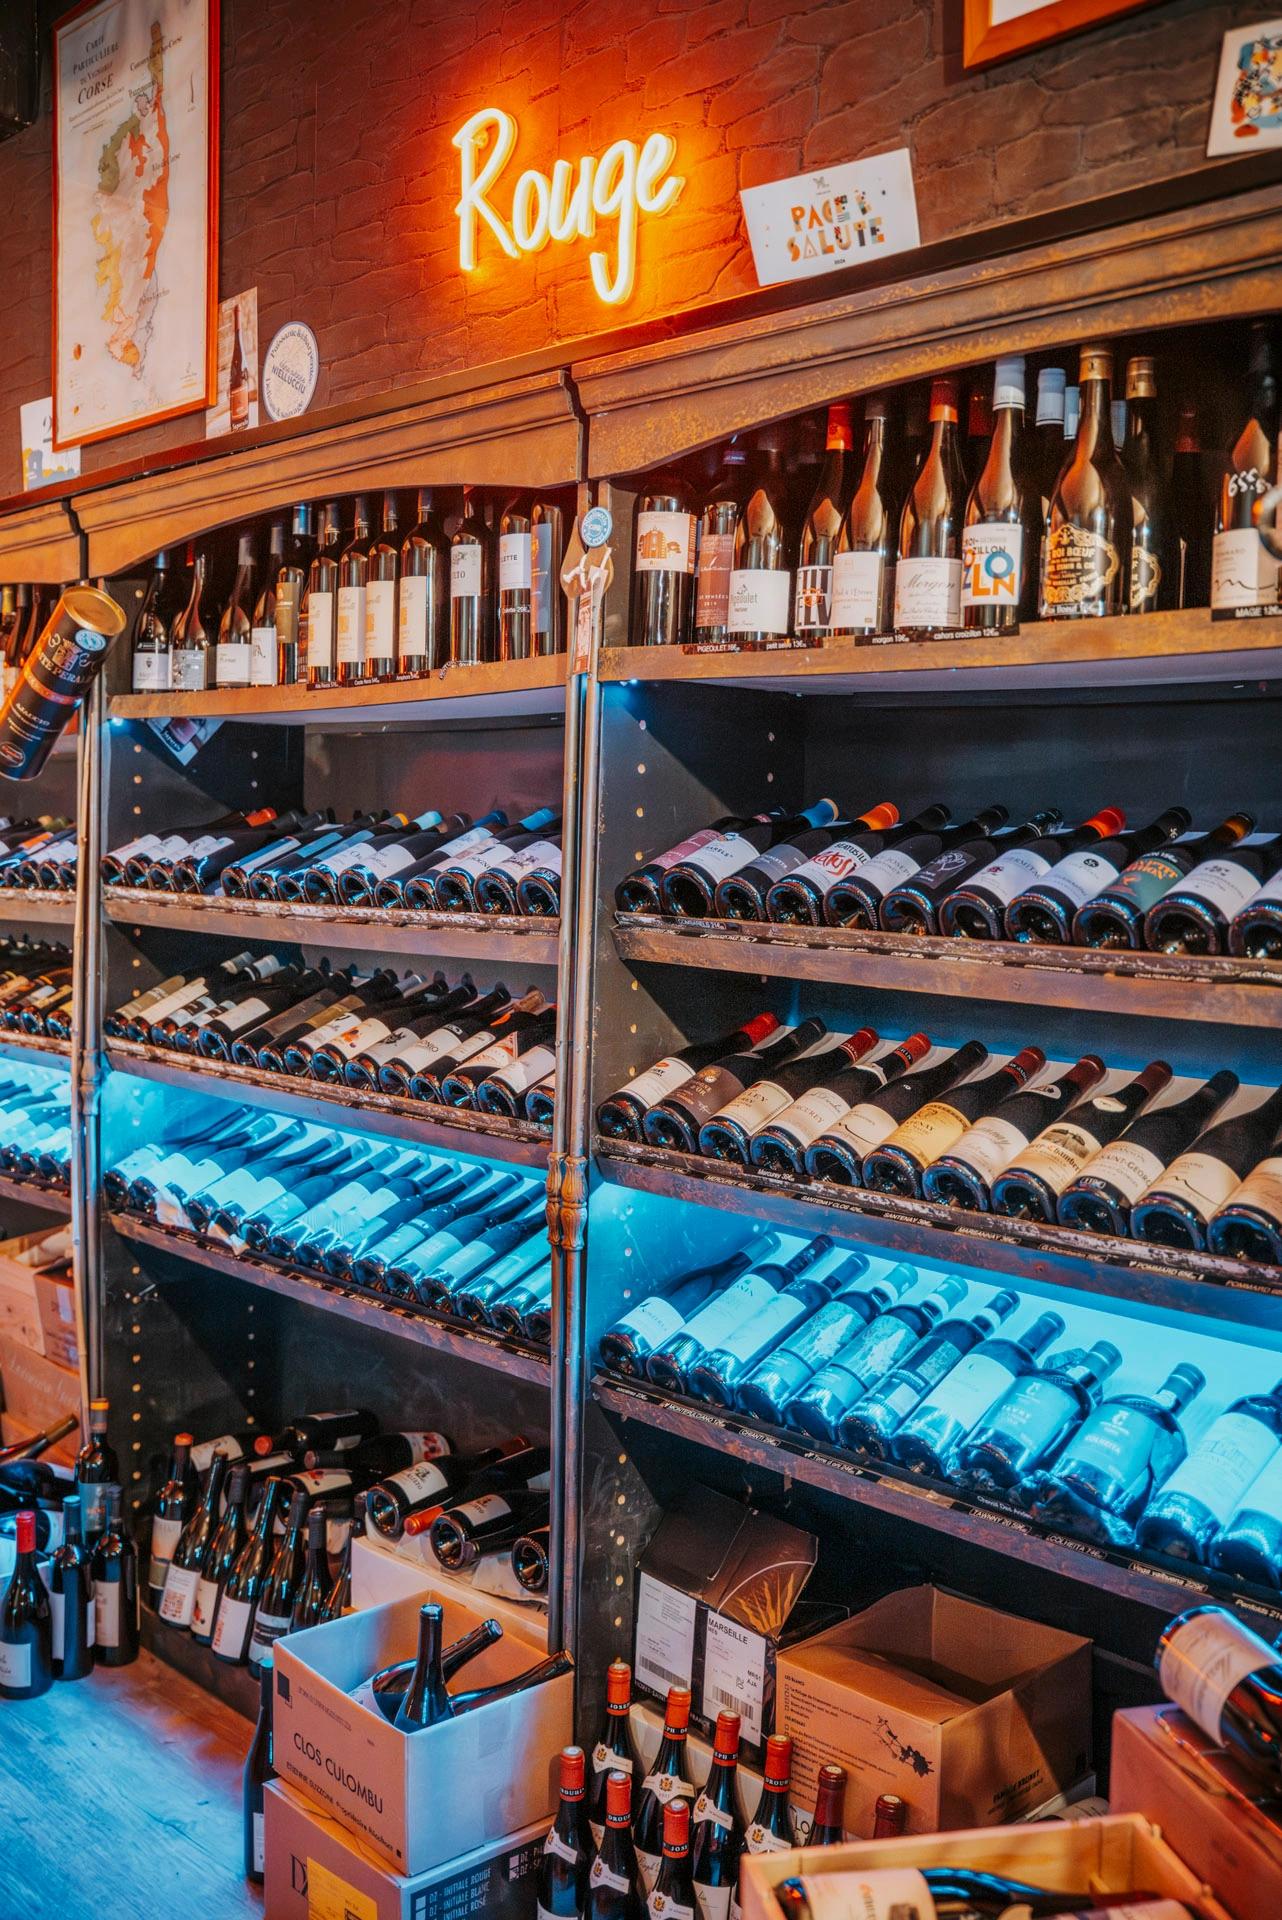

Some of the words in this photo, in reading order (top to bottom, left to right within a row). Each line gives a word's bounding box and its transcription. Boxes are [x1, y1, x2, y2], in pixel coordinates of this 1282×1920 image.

[78, 73, 114, 105] CORSE
[452, 107, 686, 304] Rouge
[787, 216, 886, 263] SALUTE
[271, 365, 307, 394] NIELLUCCIU
[871, 635, 894, 645] morgon
[933, 630, 954, 640] cahors
[757, 1168, 782, 1180] Mercurey
[801, 1194, 833, 1207] SANTENAY
[833, 1201, 850, 1211] CLOS
[883, 1212, 919, 1223] SANTENAY
[1137, 1262, 1178, 1277] POMMARD
[1226, 1279, 1271, 1294] POMMARD
[740, 1429, 766, 1443] CHIANTI
[1050, 1535, 1086, 1552] COLHEITA
[708, 1617, 748, 1646] MARSEILLE
[293, 1732, 322, 1767] CLOS
[325, 1757, 384, 1815] CULOMBU
[443, 1878, 469, 1895] INITIALE
[470, 1867, 492, 1882] ROUGE
[443, 1891, 469, 1910] INITIALE
[470, 1881, 491, 1899] BLANC
[443, 1903, 469, 1920] INITIALE
